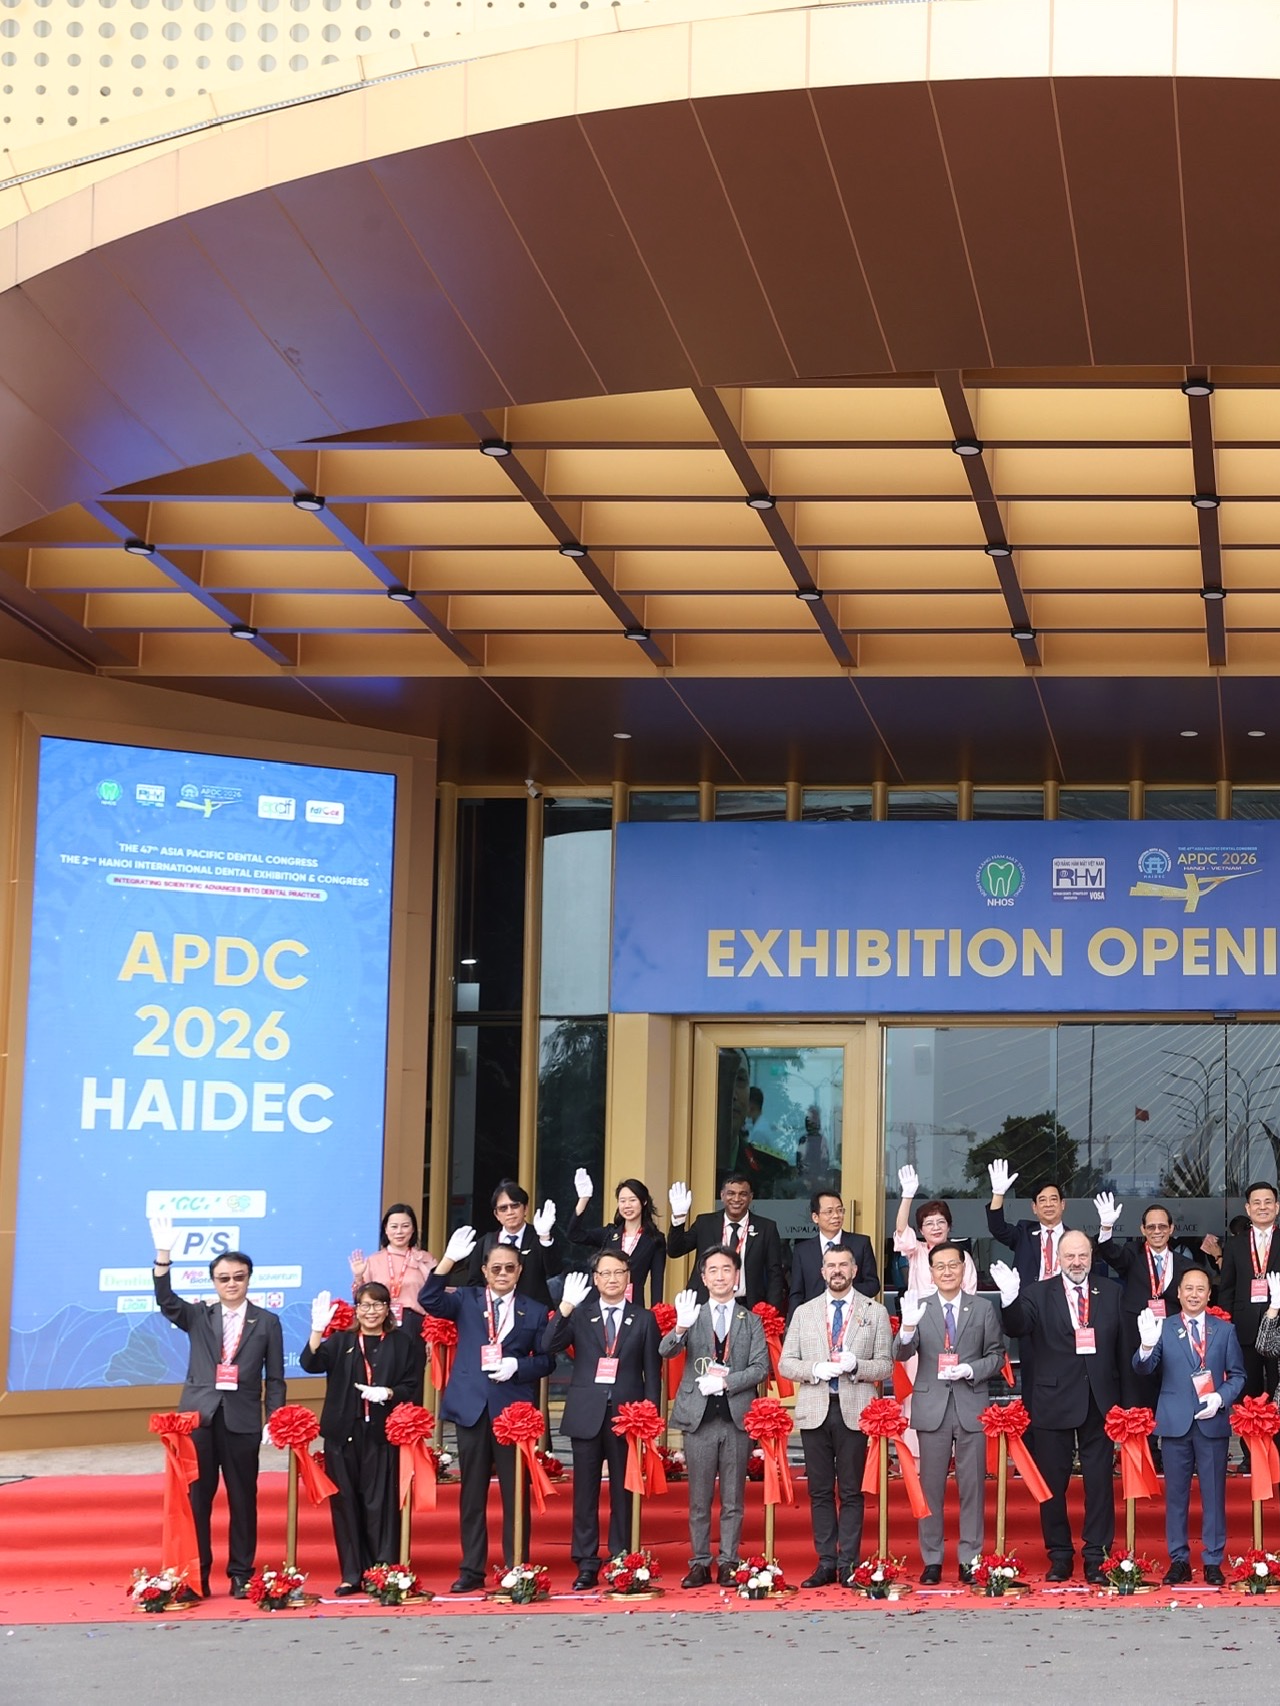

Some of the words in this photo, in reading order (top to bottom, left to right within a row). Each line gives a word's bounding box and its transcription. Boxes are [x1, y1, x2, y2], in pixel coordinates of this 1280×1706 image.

[119, 843, 139, 853] THE
[160, 847, 184, 857] ASIA
[186, 849, 225, 860] PACIFIC
[227, 852, 264, 864] DENTAL
[265, 855, 319, 868] CONGRESS
[1177, 853, 1217, 865] APDC
[1222, 852, 1257, 865] 2026
[60, 854, 80, 865] THE
[99, 857, 133, 869] HANOI
[135, 860, 213, 875] INTERNATIONAL
[214, 866, 252, 878] DENTAL
[254, 869, 307, 882] EXHIBITION
[308, 873, 316, 883] &
[317, 875, 370, 887] CONGRESS
[113, 877, 161, 886] INTEGRATING
[164, 880, 202, 889] SCIENTIFIC
[205, 883, 241, 893] ADVANCES
[243, 886, 260, 894] INTO
[261, 888, 287, 897] DENTAL
[289, 890, 321, 899] PRACTICE
[1090, 891, 1105, 900] VOSA
[987, 898, 1015, 907] NHOS
[117, 930, 311, 991] APDC
[707, 927, 1063, 978] EXHIBITION
[132, 1004, 291, 1061] 2026
[80, 1076, 335, 1134] HAIDEC
[183, 1232, 230, 1255] P/S
[258, 1272, 298, 1281] solventum
